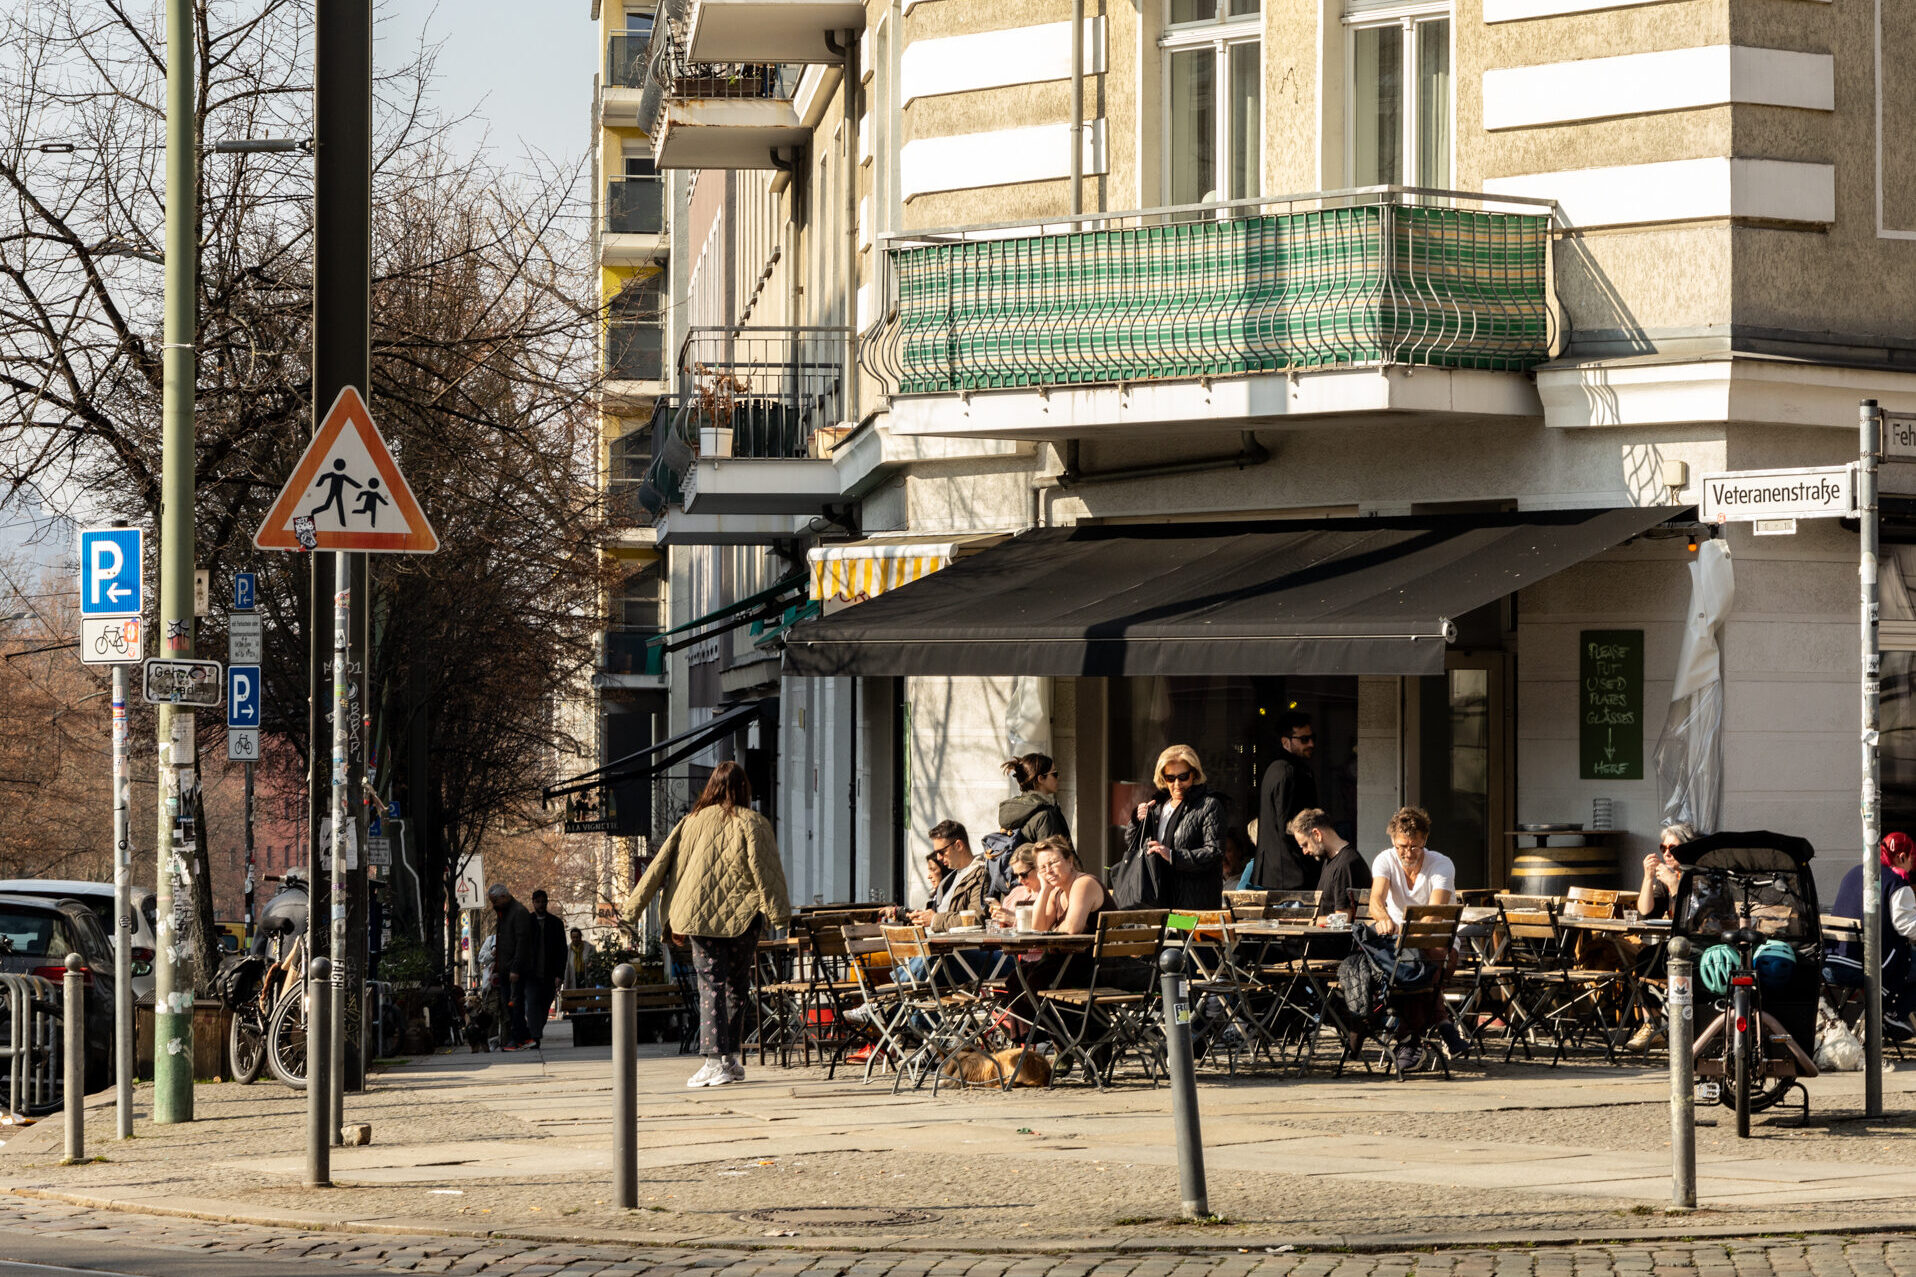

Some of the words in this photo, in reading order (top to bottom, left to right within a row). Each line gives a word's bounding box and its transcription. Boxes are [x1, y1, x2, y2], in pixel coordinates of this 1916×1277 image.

[1712, 477, 1841, 506] Veteranenstraße
[91, 541, 124, 604] P
[237, 577, 249, 605] P
[1588, 643, 1631, 660] PLEASE
[1596, 661, 1623, 676] PUT
[1586, 676, 1627, 691] USED
[233, 674, 250, 719] P
[1589, 692, 1627, 706] PLATES
[1586, 711, 1635, 725] GLASSES
[1593, 760, 1630, 775] HERE
